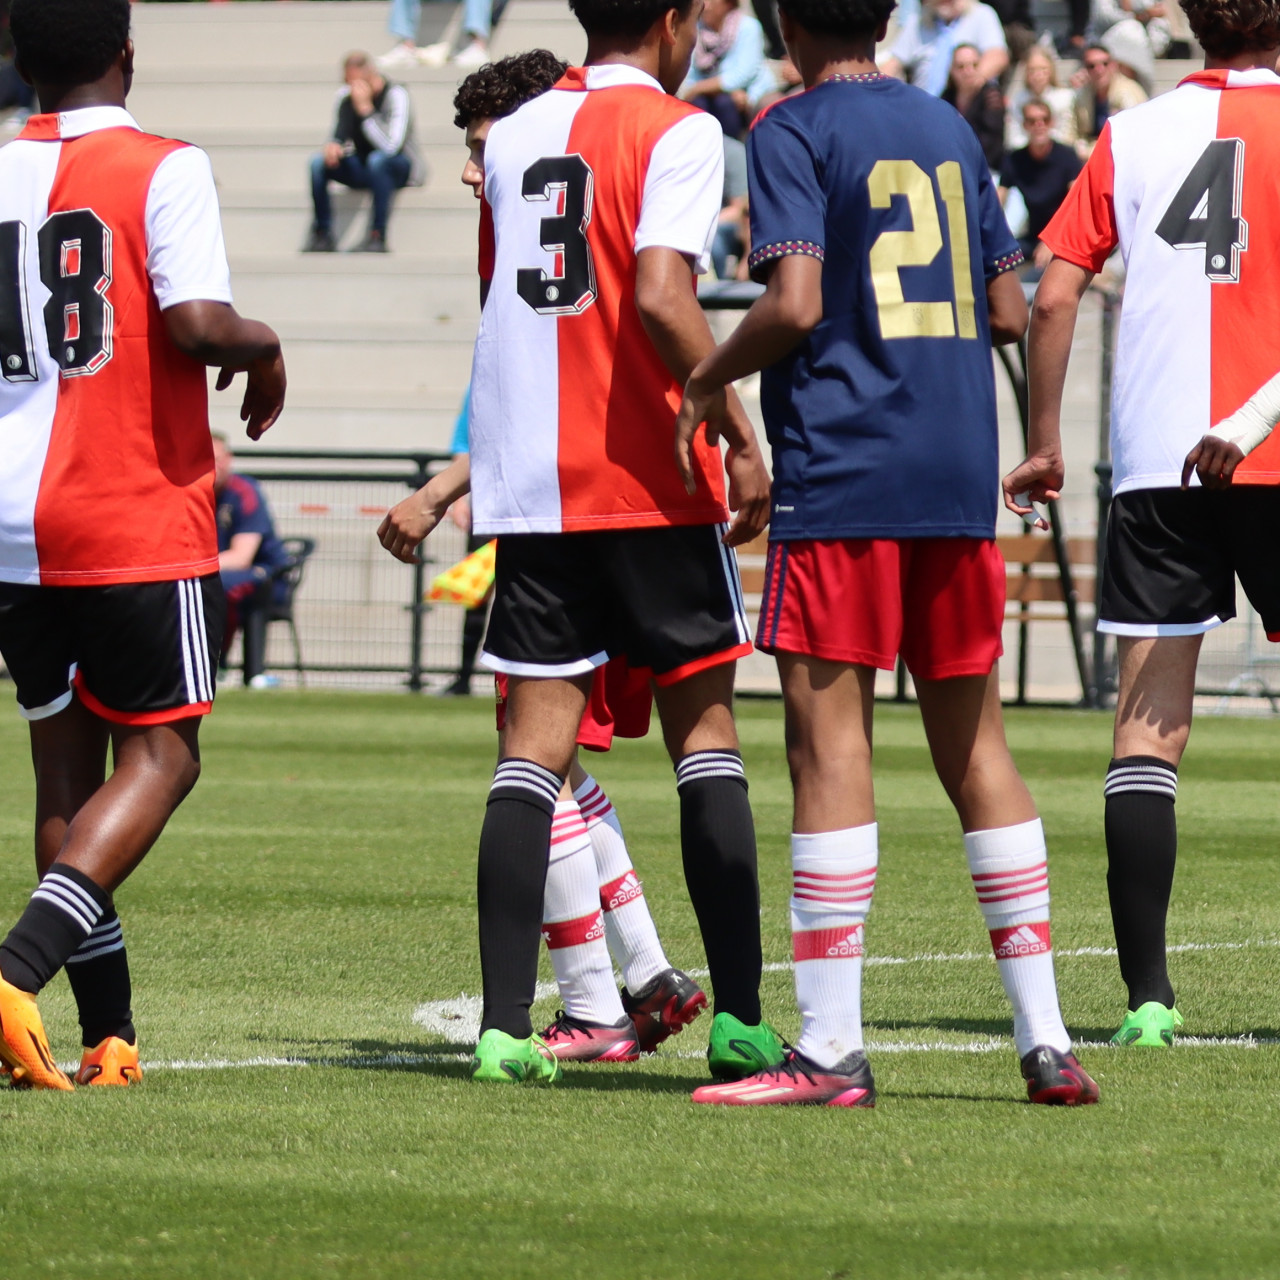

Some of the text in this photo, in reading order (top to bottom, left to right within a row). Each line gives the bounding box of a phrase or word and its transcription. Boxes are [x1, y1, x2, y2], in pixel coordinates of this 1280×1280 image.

[517, 152, 598, 316] 3
[867, 159, 978, 340] 21
[1155, 137, 1249, 284] 4
[0, 207, 114, 383] 18
[997, 941, 1049, 956] adidas
